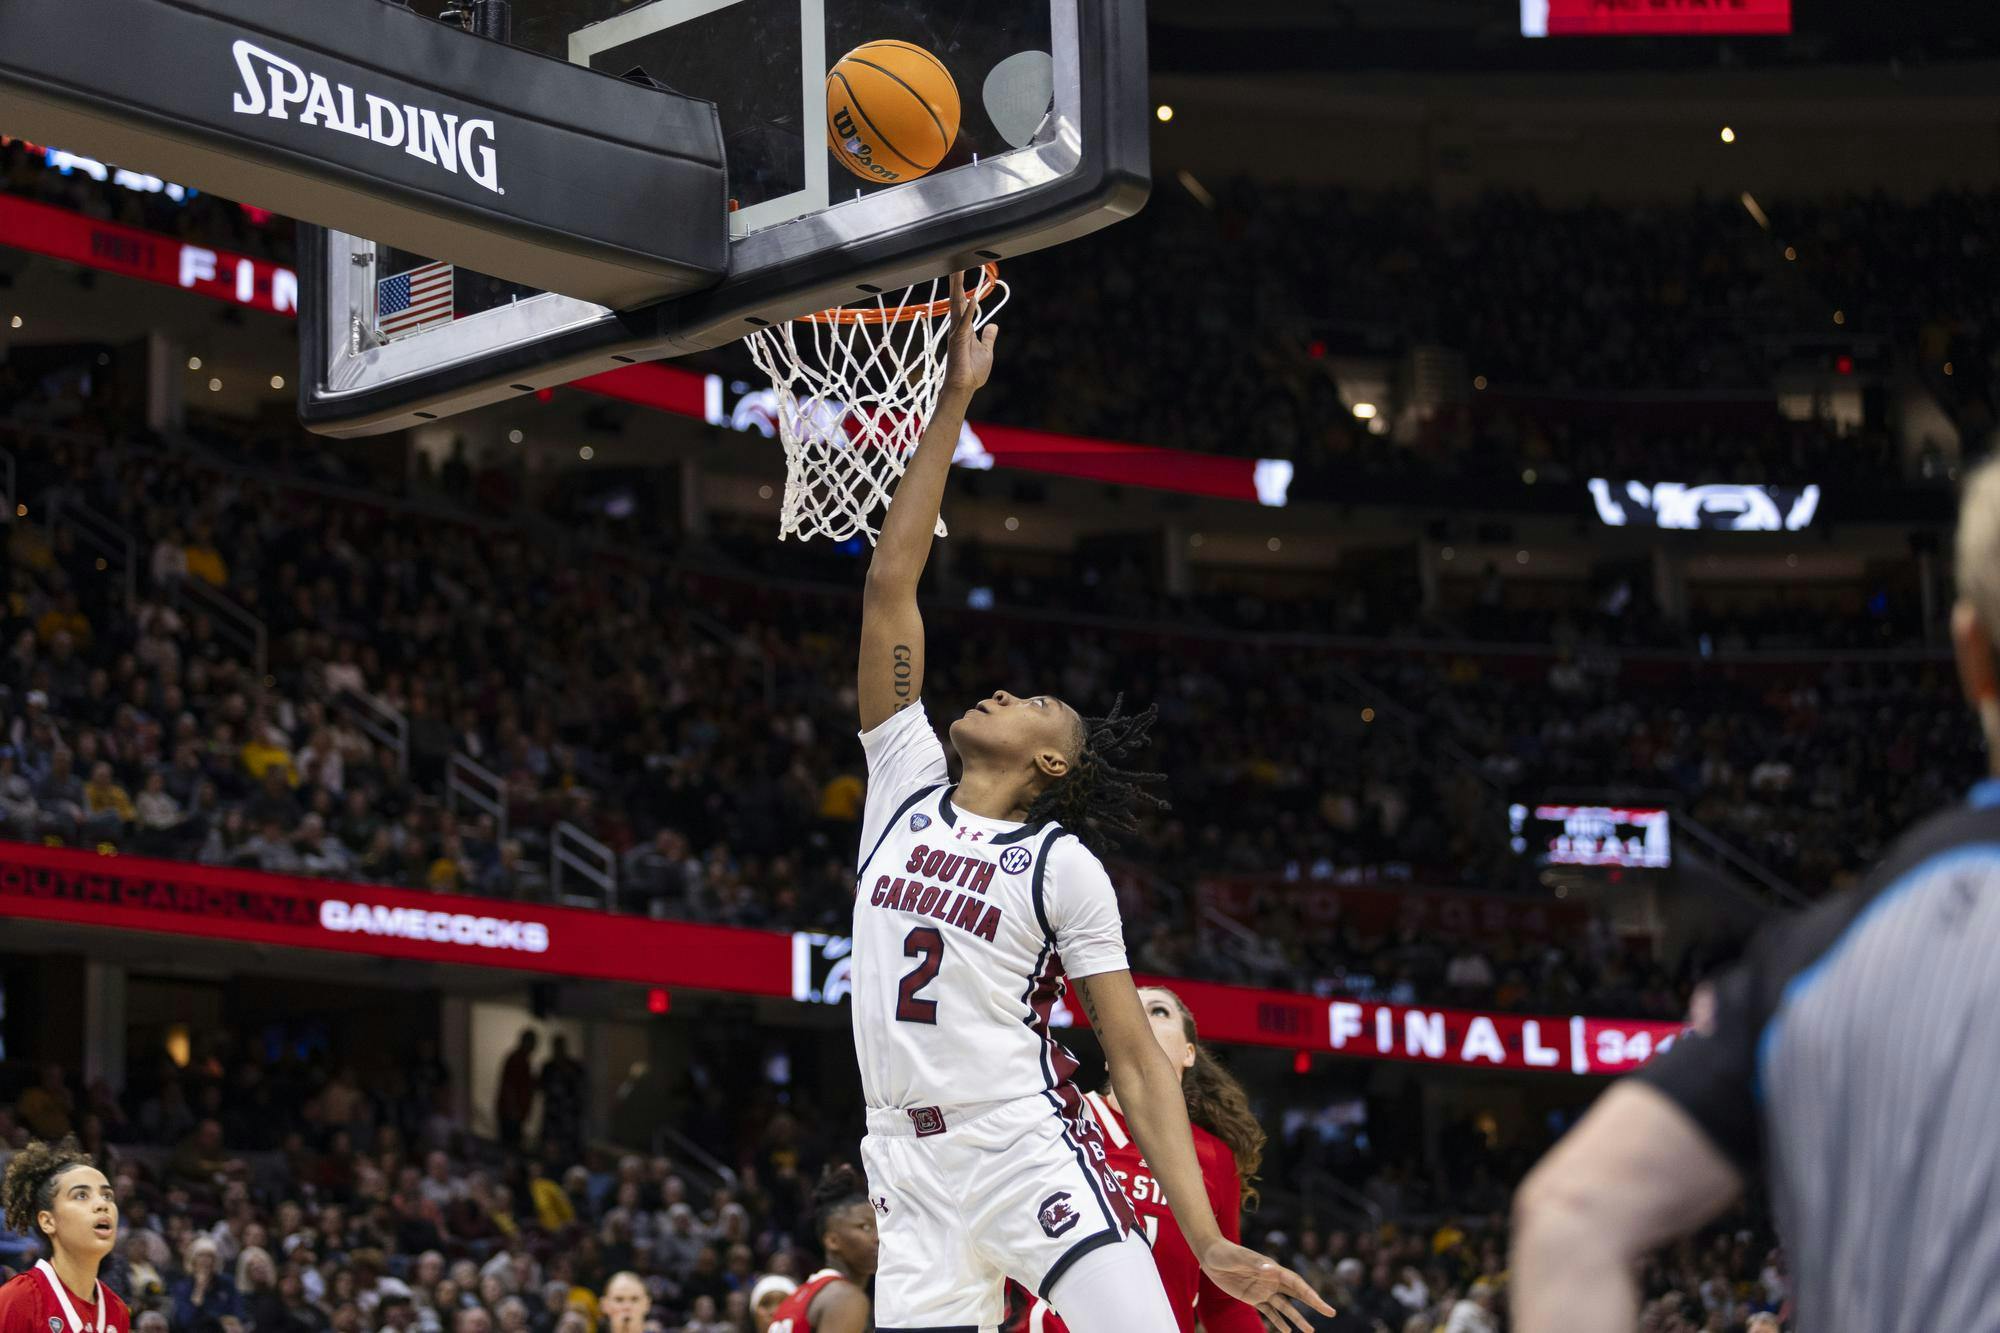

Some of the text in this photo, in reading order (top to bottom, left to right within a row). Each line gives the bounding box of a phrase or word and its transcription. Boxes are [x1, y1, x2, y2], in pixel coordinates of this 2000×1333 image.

[232, 40, 498, 192] SPALDING
[180, 246, 298, 312] FIN
[0, 862, 113, 905] OUTH
[905, 844, 997, 895] SOUTH
[1001, 848, 1030, 873] SEC
[320, 900, 549, 953] GAMECOCKS
[870, 875, 1002, 943] CAROLINA
[895, 926, 945, 1025] 2
[1328, 1002, 1559, 1066] FINAL
